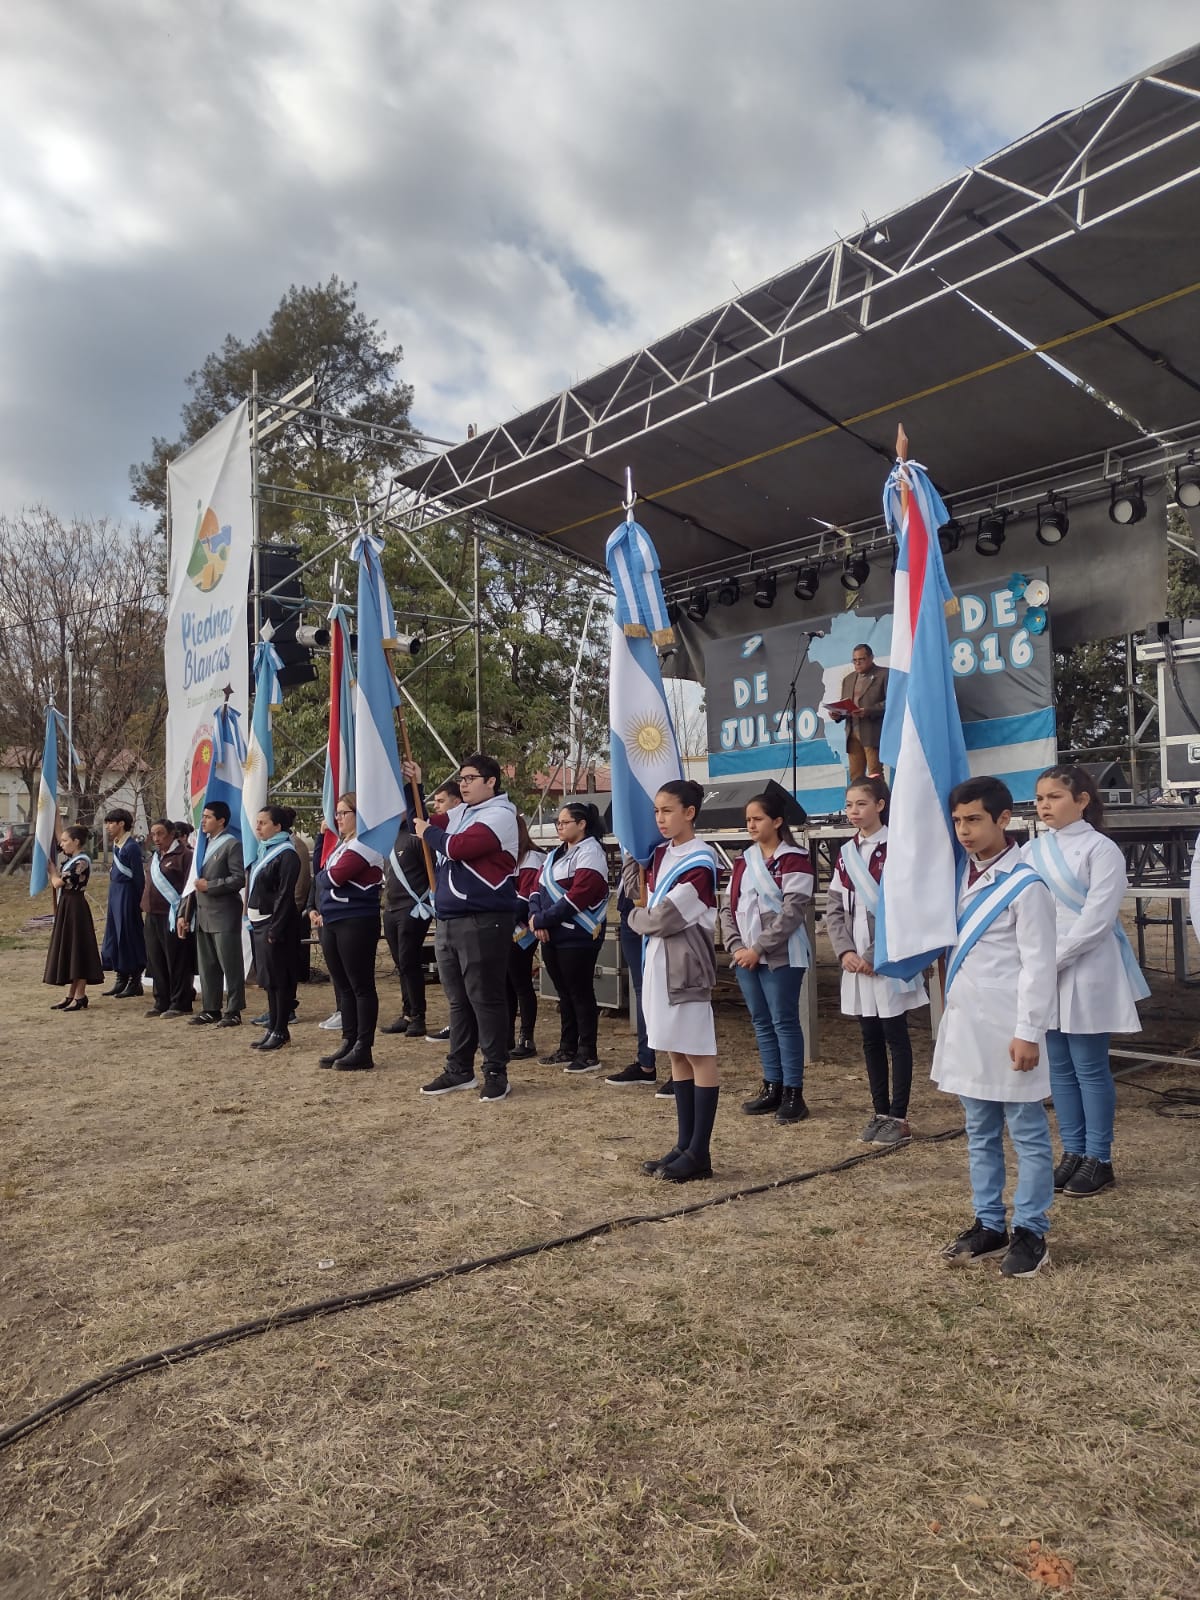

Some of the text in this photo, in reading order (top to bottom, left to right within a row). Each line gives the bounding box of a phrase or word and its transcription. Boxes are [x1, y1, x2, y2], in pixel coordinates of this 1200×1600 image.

[182, 605, 233, 651] Piedras
[961, 590, 1018, 632] DE
[183, 643, 229, 690] Blancas
[741, 634, 763, 658] 9
[952, 629, 1034, 676] 816
[734, 672, 768, 708] DE
[721, 707, 818, 749] JULIO
